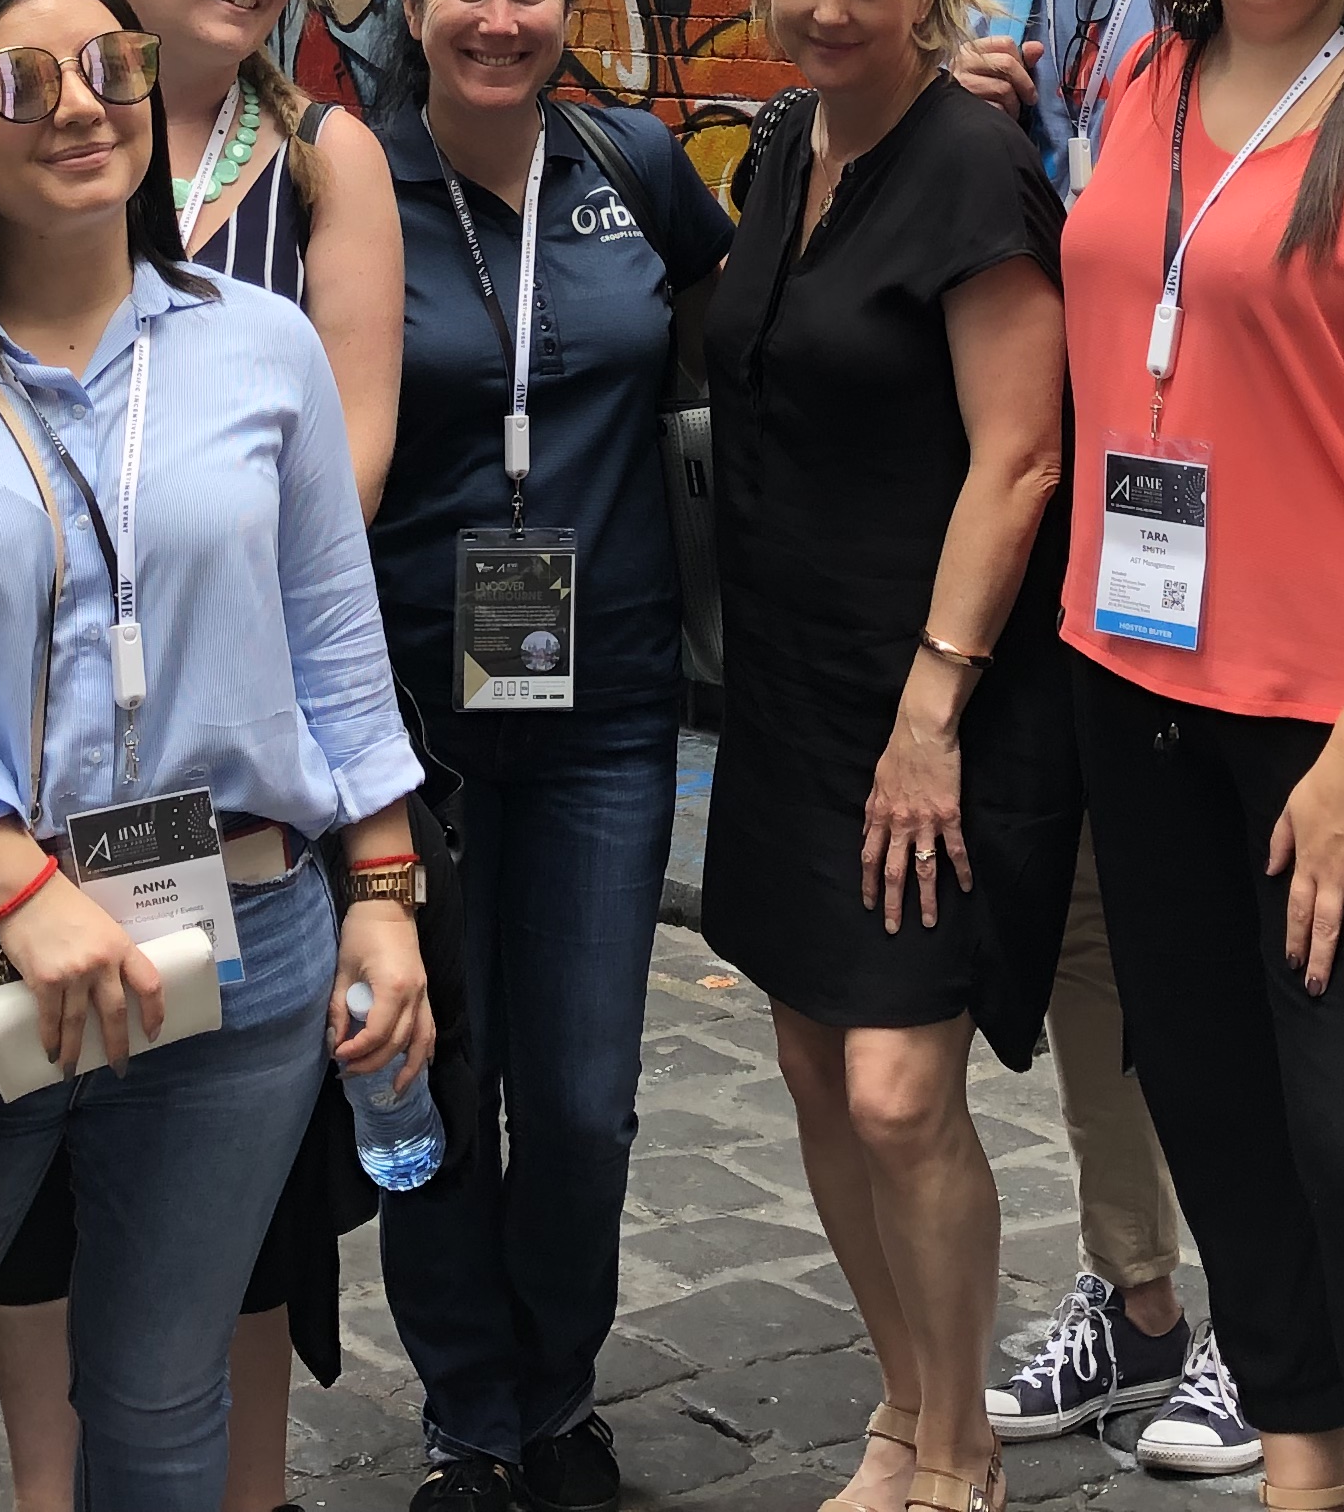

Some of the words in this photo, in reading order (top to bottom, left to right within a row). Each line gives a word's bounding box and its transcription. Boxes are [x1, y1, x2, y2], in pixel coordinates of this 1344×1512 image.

[477, 266, 495, 297] WHEN
[135, 362, 143, 393] PACIFIC
[515, 377, 527, 412] AIME
[130, 394, 140, 441] INCENTIVES
[122, 504, 130, 535] EVENT
[1139, 529, 1169, 543] TARA
[1142, 544, 1167, 556] SMITH
[119, 573, 133, 620] AIME
[133, 878, 177, 896] ANNA
[136, 894, 179, 909] MARINO
